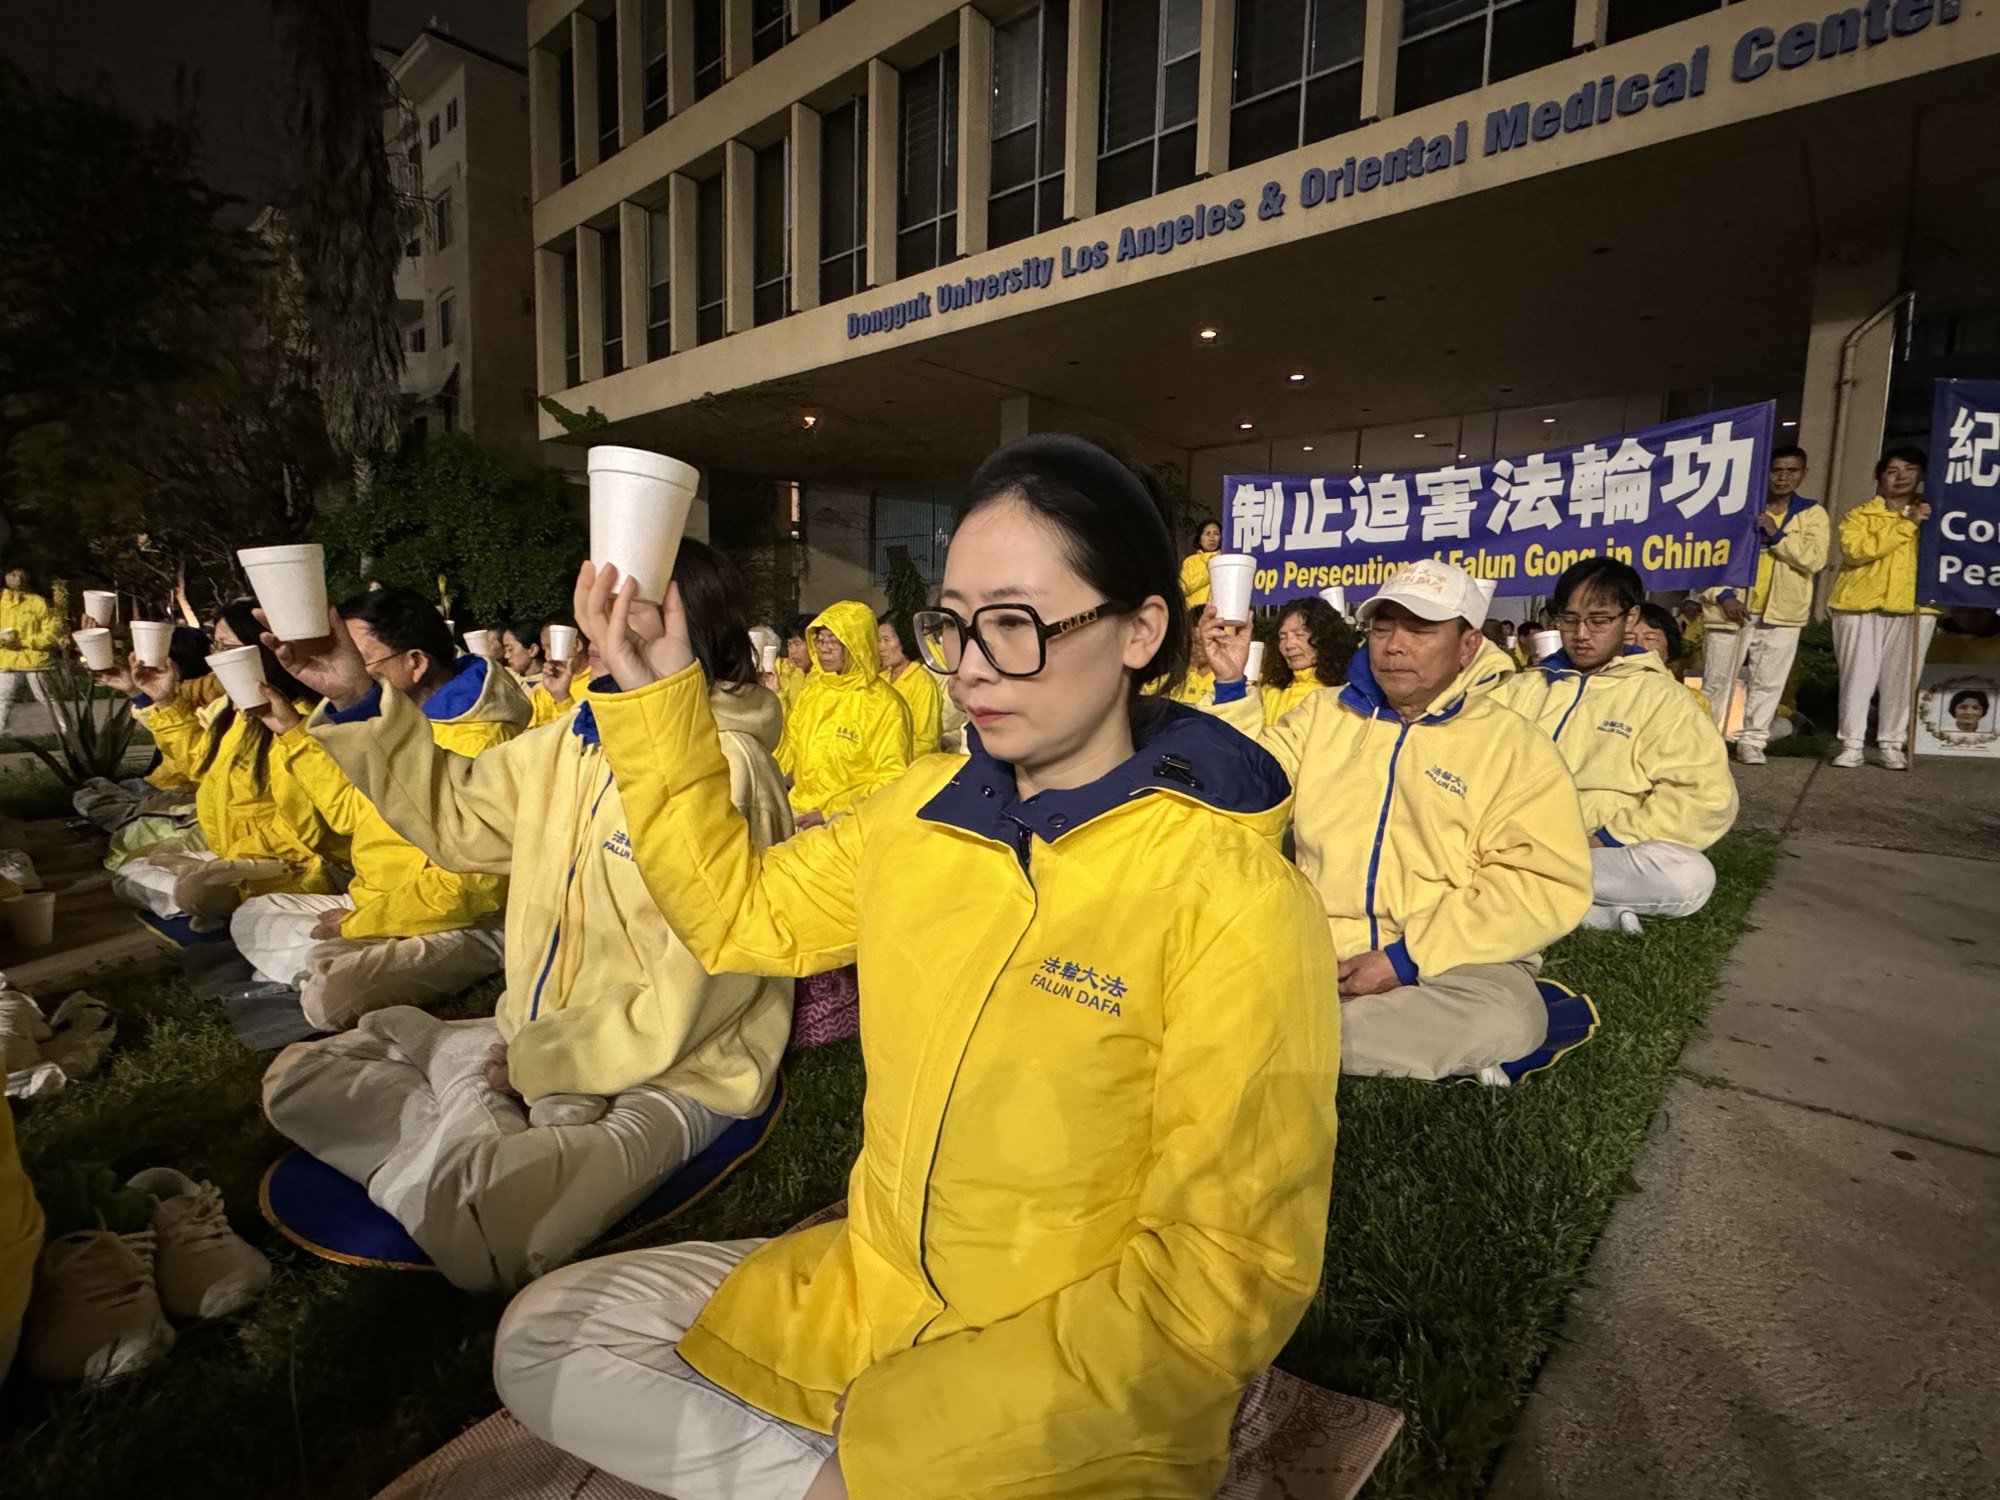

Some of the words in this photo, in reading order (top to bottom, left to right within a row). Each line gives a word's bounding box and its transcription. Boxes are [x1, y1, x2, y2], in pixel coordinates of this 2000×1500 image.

[847, 292, 931, 339] Dongguk
[937, 256, 1054, 313] University
[1062, 241, 1108, 278] Los
[1117, 198, 1245, 262] Angeles
[1258, 181, 1285, 220] &
[1300, 120, 1468, 208] Oriental
[1484, 45, 1710, 157] Medical
[1232, 421, 1755, 553] 制止迫害法輪功
[1940, 511, 2000, 543] Co
[1254, 568, 1278, 595] op
[1642, 531, 1732, 570] China
[1030, 973, 1074, 999] FALUN
[1075, 990, 1121, 1017] DAFA
[1040, 956, 1128, 998] 法輪大法
